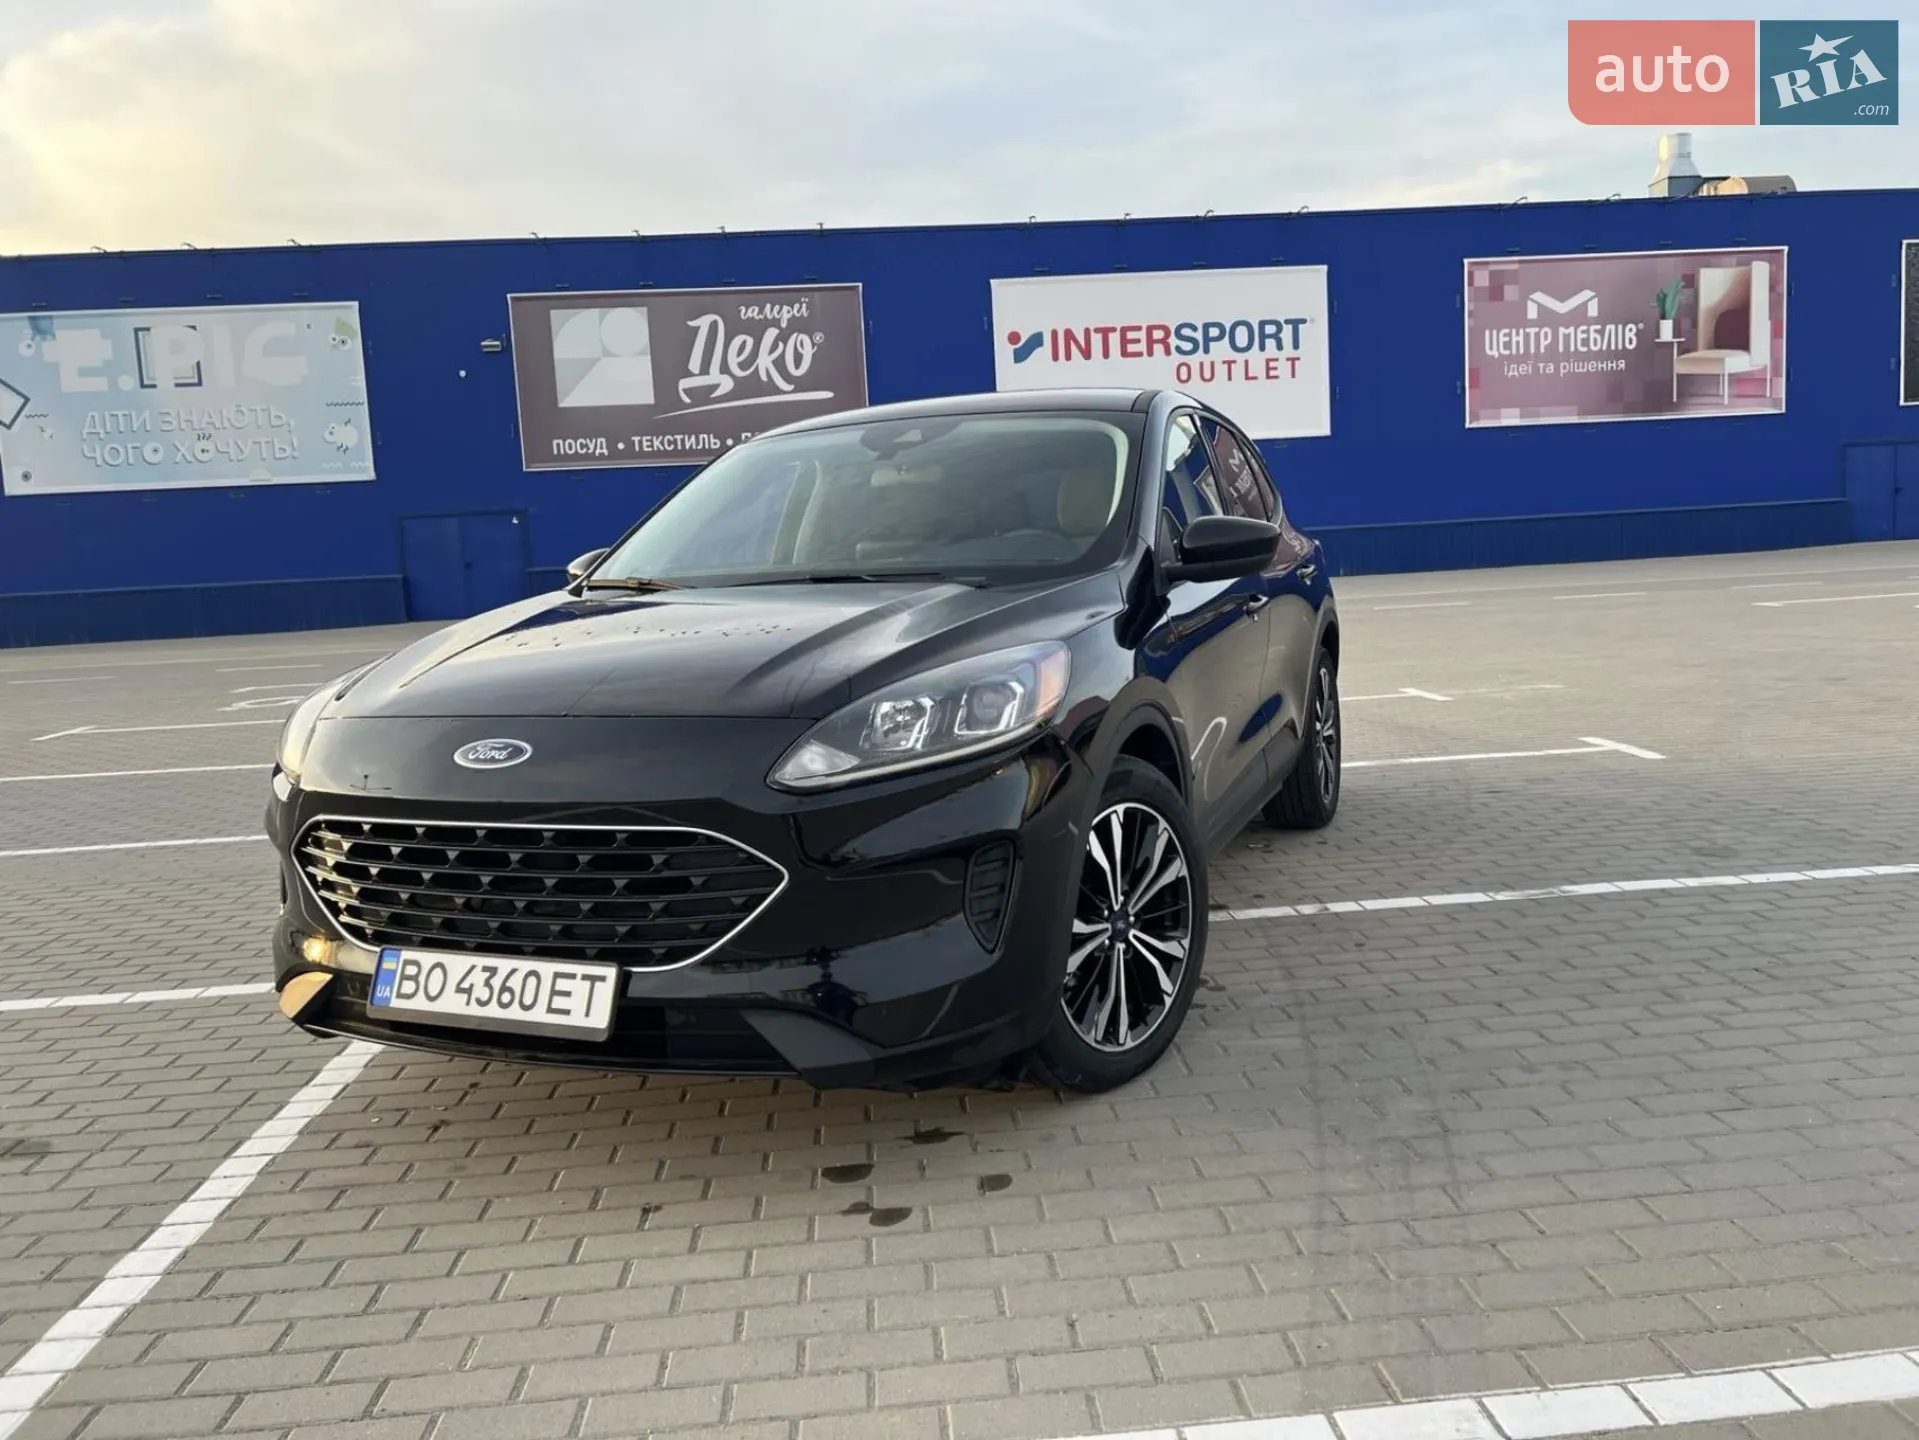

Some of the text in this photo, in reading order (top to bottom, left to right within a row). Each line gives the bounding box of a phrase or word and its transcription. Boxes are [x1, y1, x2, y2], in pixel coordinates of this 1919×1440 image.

[738, 298, 810, 329] галереї
[1051, 318, 1308, 362] INTERSPORT
[1484, 323, 1638, 358] ЦЕНТР МЕБЛІВ
[1176, 357, 1301, 385] OUTLET
[1504, 359, 1626, 378] ідеї та рішення
[81, 410, 152, 440] ДІТИ
[81, 436, 300, 468] ЧОГО ХОЧУТЬ!
[552, 437, 609, 457] ПОСУД
[631, 433, 721, 453] ТЕКСТИЛЬ
[468, 743, 514, 760] Ford
[377, 985, 392, 998] UA
[454, 964, 542, 1012] 4360
